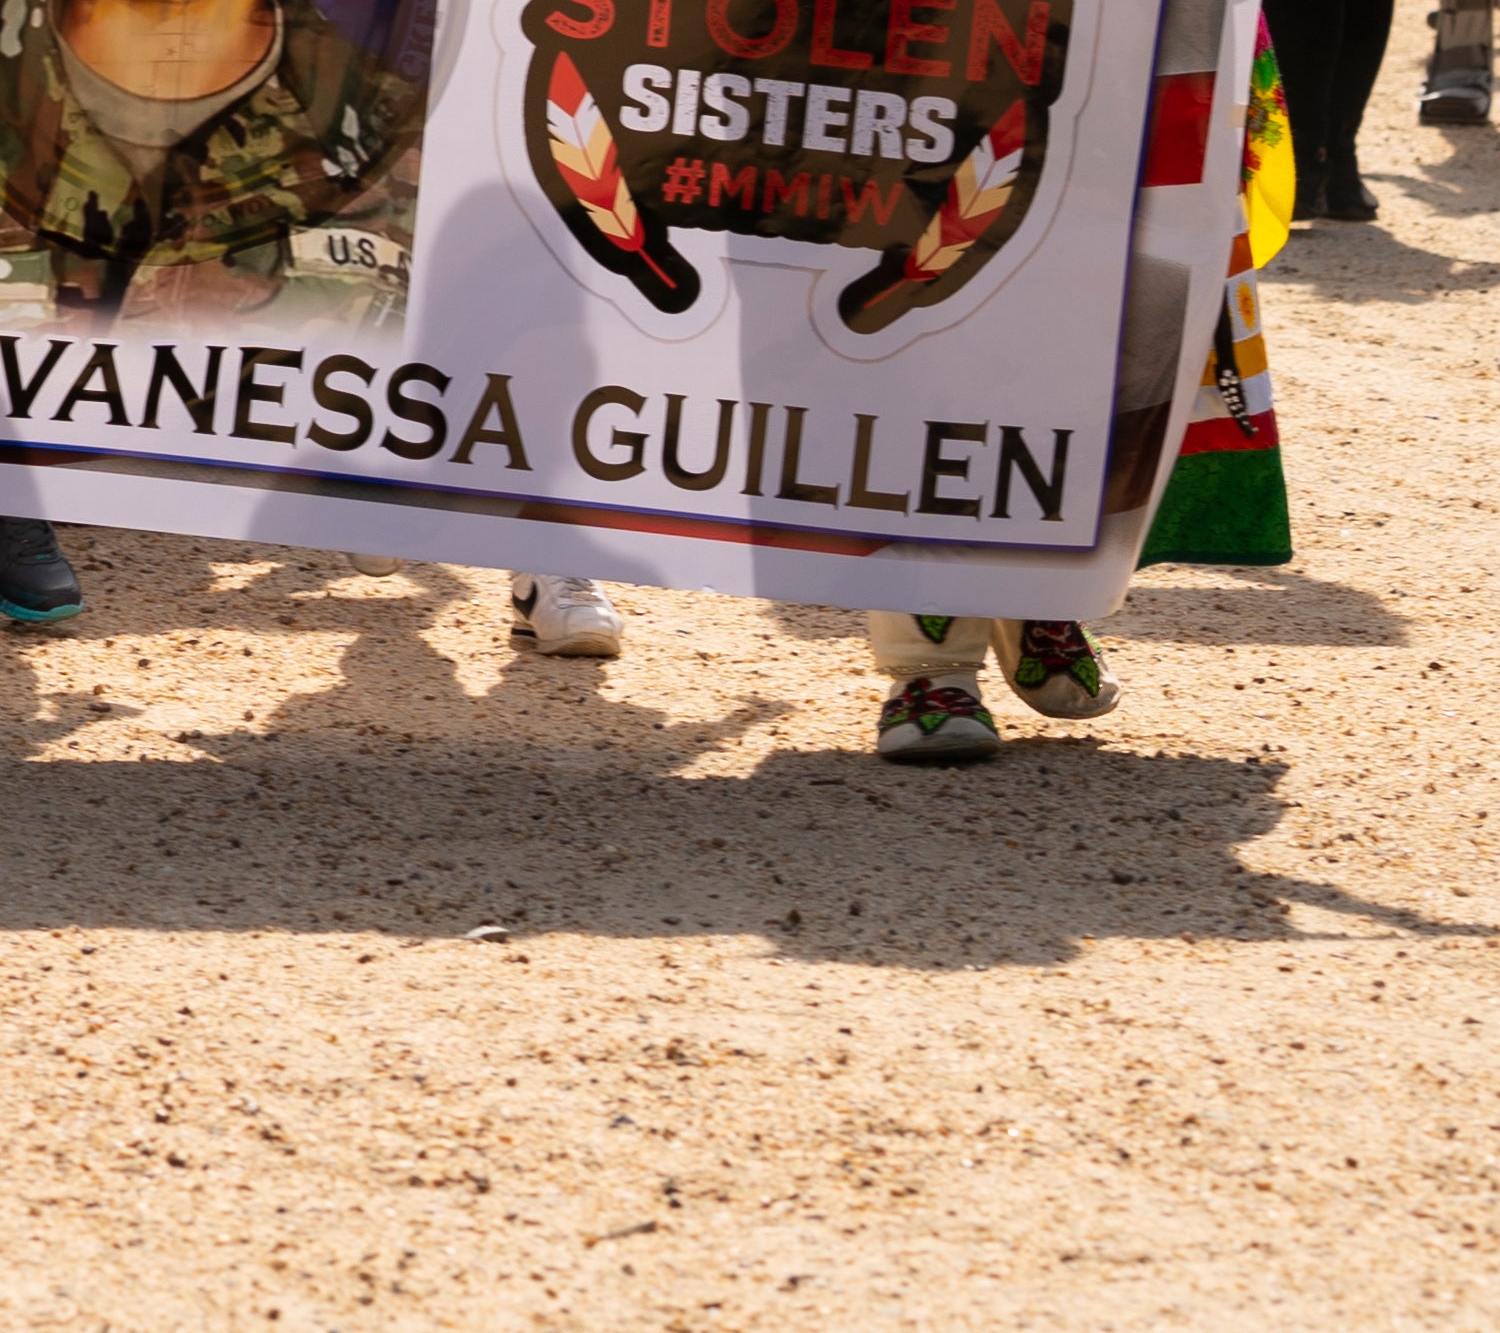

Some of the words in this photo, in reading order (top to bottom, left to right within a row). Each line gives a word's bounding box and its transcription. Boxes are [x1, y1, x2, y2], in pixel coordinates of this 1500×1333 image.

[620, 62, 958, 165] SISTERS
[663, 155, 907, 228] #MMIW
[569, 384, 1076, 523] GUILLEN
